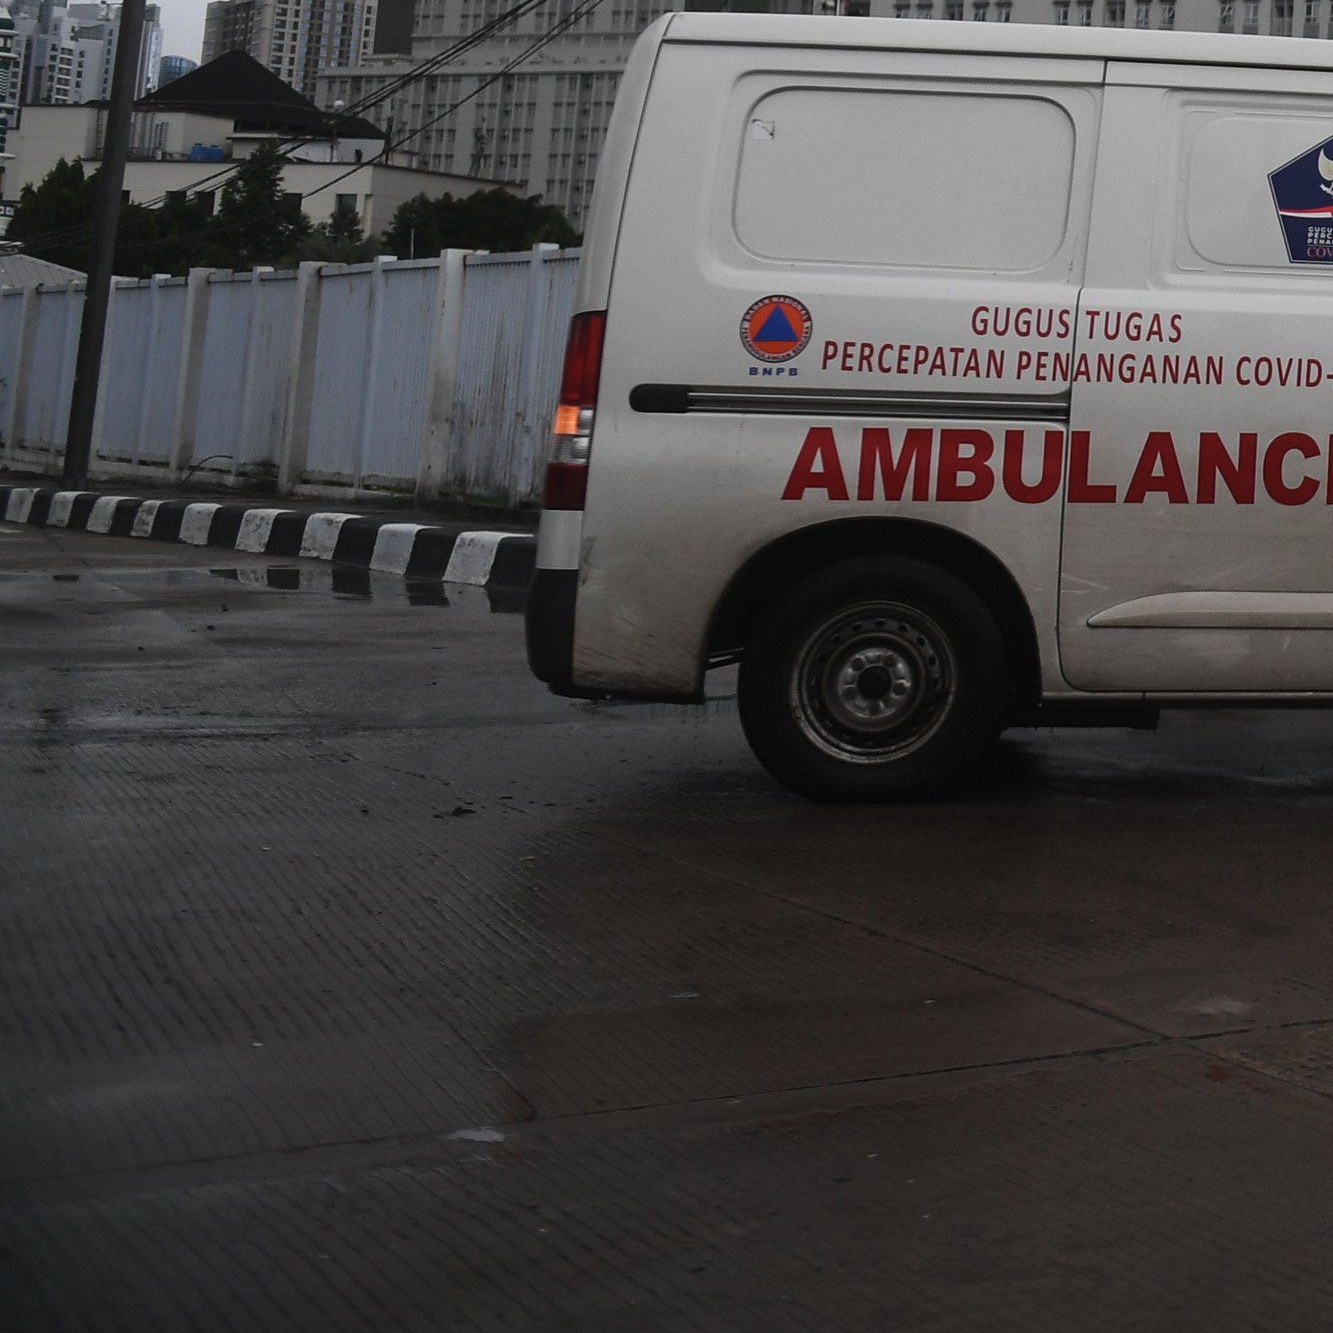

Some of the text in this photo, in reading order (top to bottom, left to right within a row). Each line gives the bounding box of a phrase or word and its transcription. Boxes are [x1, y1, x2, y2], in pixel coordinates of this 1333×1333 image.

[971, 305, 1183, 344] GUGUS TUGAS
[748, 366, 798, 376] BNPB
[822, 340, 1006, 379] PERCEPATAN
[1016, 350, 1223, 386] PENANGANAN
